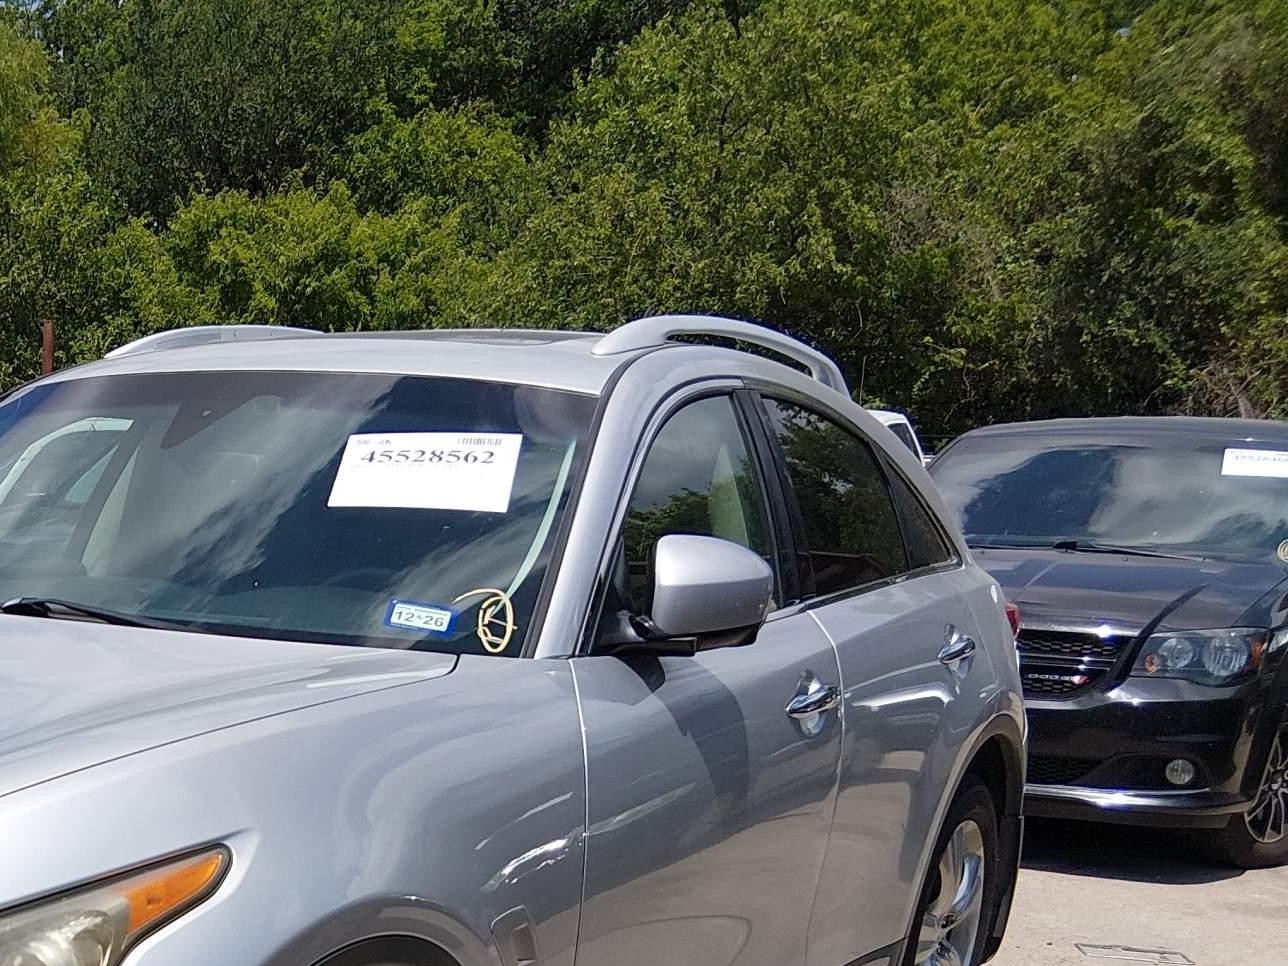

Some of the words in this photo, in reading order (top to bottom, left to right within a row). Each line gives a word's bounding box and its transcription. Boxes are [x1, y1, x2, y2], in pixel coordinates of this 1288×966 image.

[361, 449, 495, 464] 45528562
[395, 611, 414, 623] 12
[422, 615, 444, 628] 26
